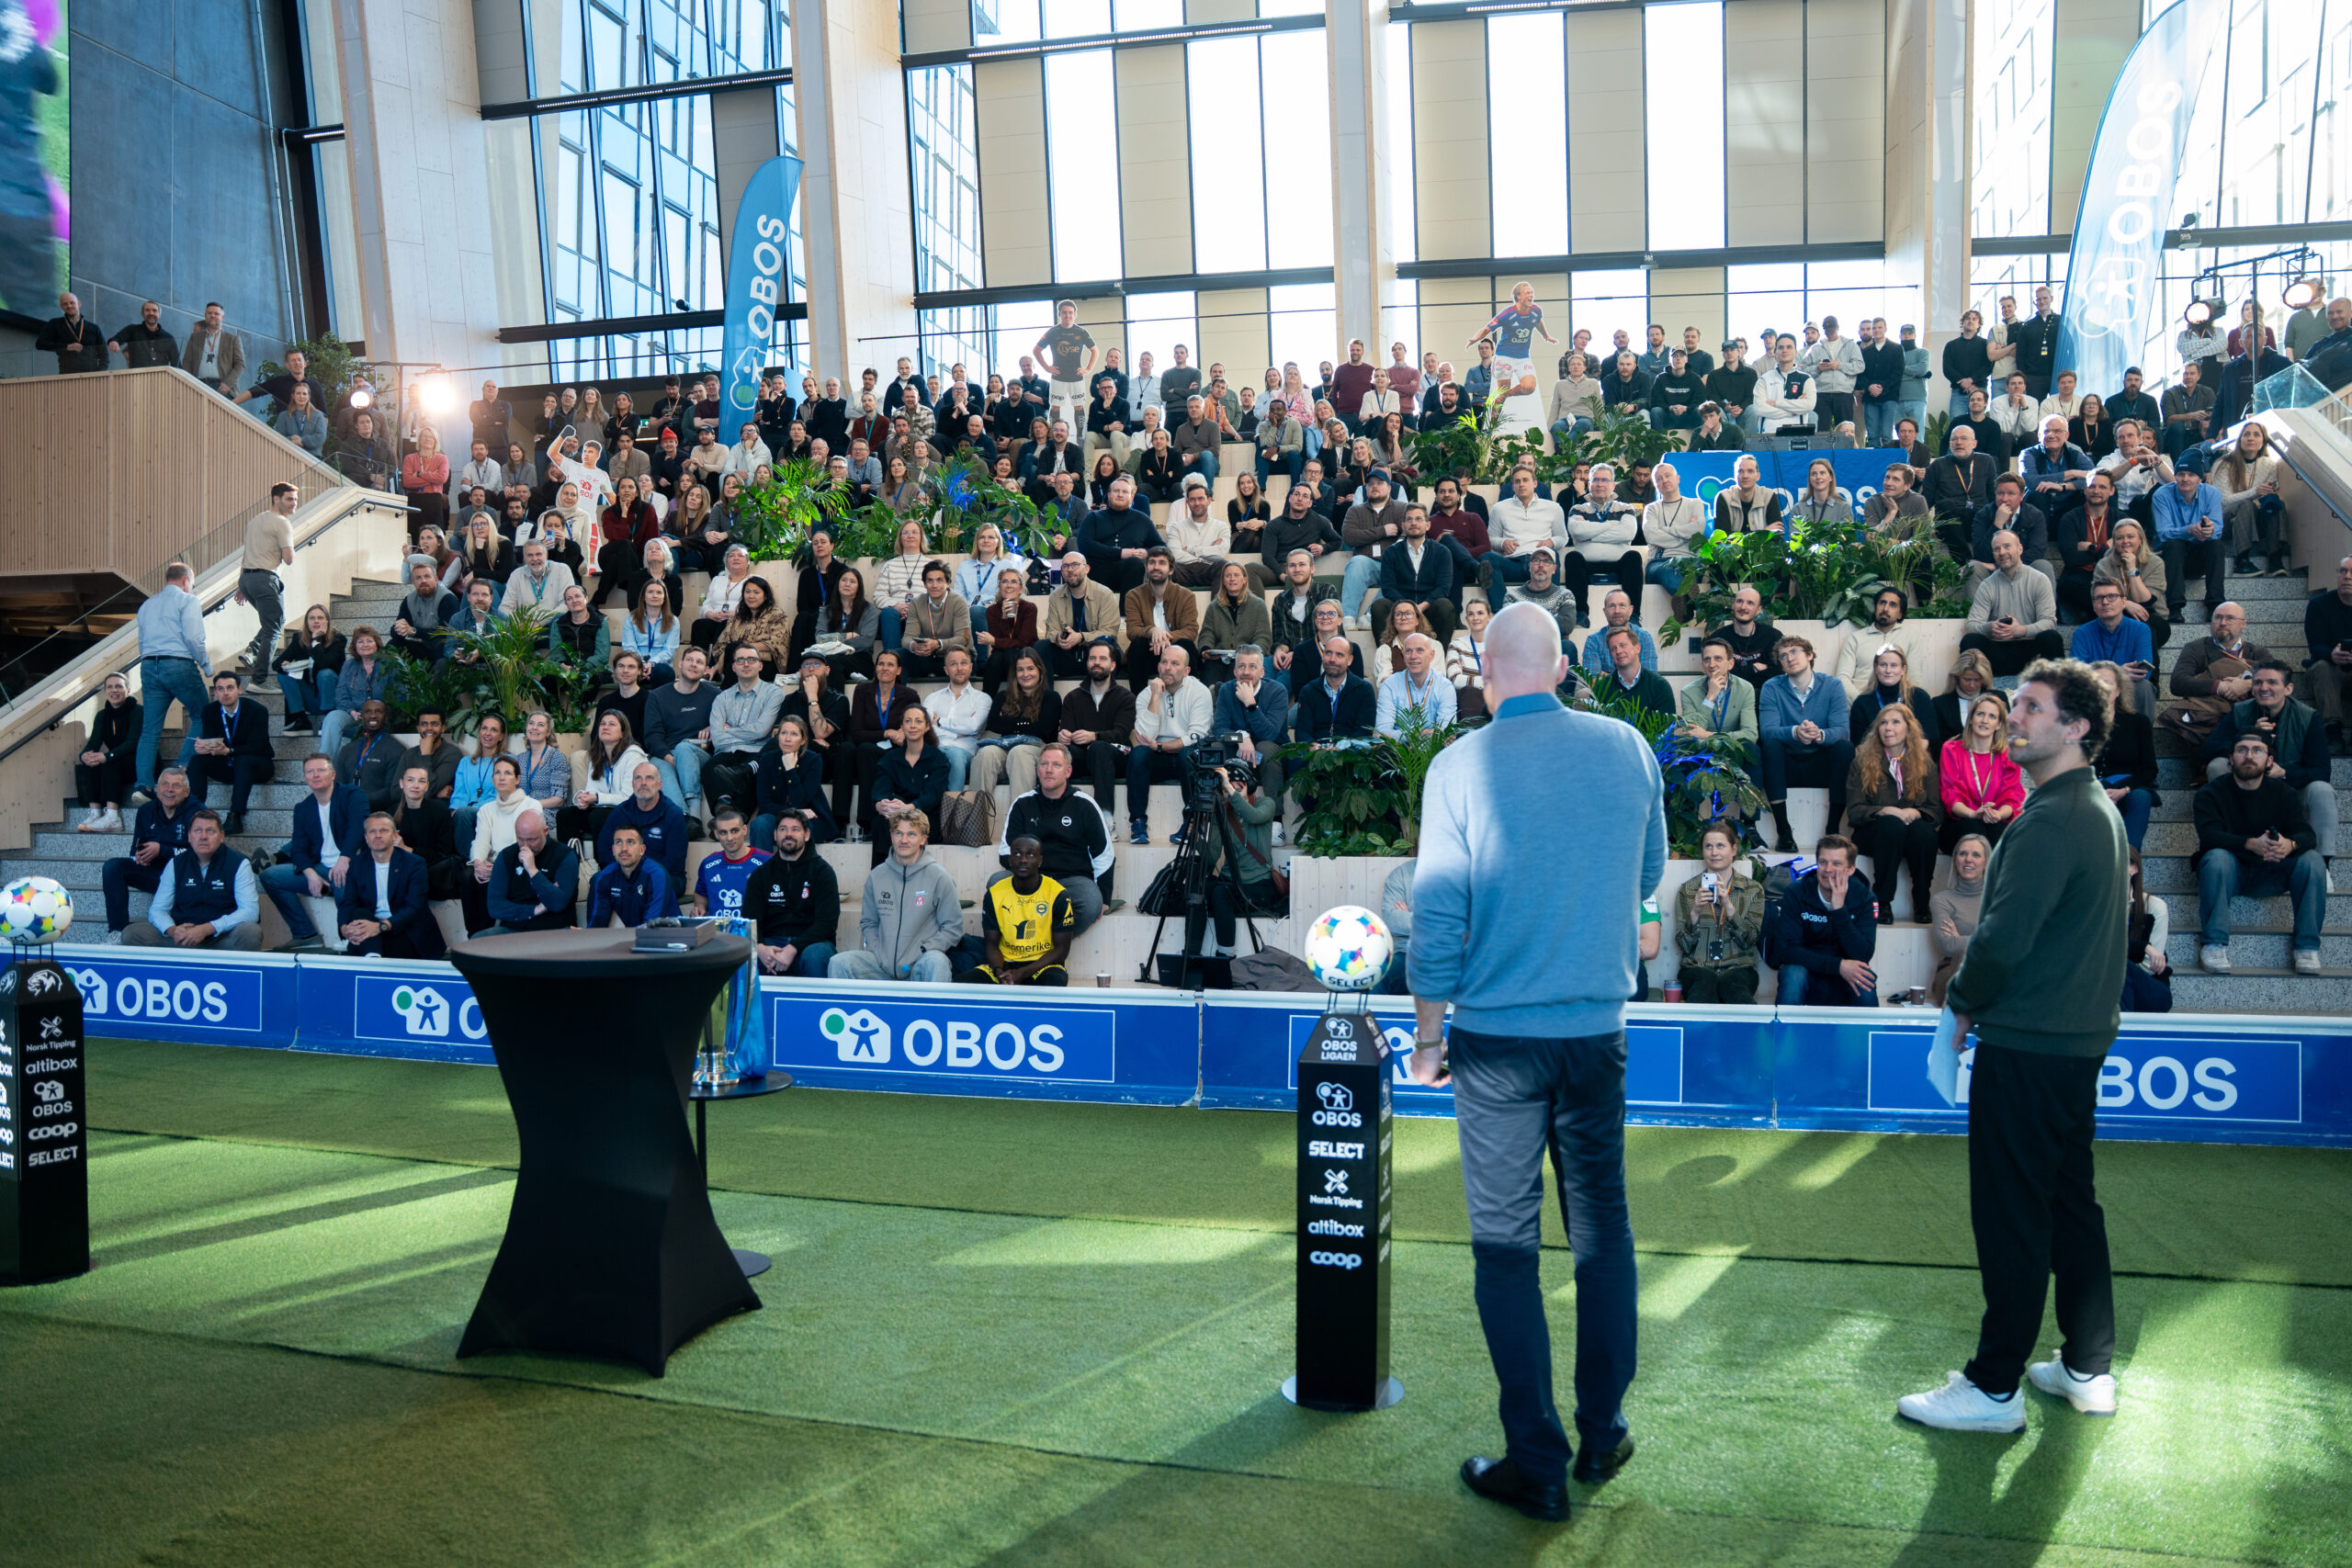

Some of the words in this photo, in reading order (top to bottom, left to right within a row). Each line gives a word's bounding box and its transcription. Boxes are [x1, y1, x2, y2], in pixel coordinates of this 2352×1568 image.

[2108, 81, 2183, 245] OBOS
[747, 214, 786, 340] OBOS
[580, 490, 594, 500] BOS
[706, 859, 722, 869] coop
[716, 909, 741, 919] OBO
[1808, 914, 1828, 923] OBOS
[1329, 974, 1375, 987] SELECT
[116, 976, 228, 1021] OBOS
[26, 1042, 49, 1053] Norsk
[49, 1039, 76, 1051] Tipping
[903, 1019, 1065, 1073] OBOS
[1321, 1039, 1358, 1052] OBOS
[1320, 1051, 1357, 1062] LIGAEN
[25, 1057, 78, 1075] altibox
[2096, 1055, 2238, 1111] BOS
[32, 1100, 74, 1118] OBOS
[1312, 1110, 1362, 1128] OBOS
[28, 1122, 78, 1141] coop
[28, 1145, 79, 1168] SELECT
[1308, 1140, 1365, 1160] SELECT
[0, 1152, 15, 1170] LECT
[1309, 1194, 1333, 1205] Norsk
[1333, 1196, 1363, 1210] Tipping
[1307, 1218, 1365, 1238] altibox
[1309, 1250, 1363, 1270] coop
